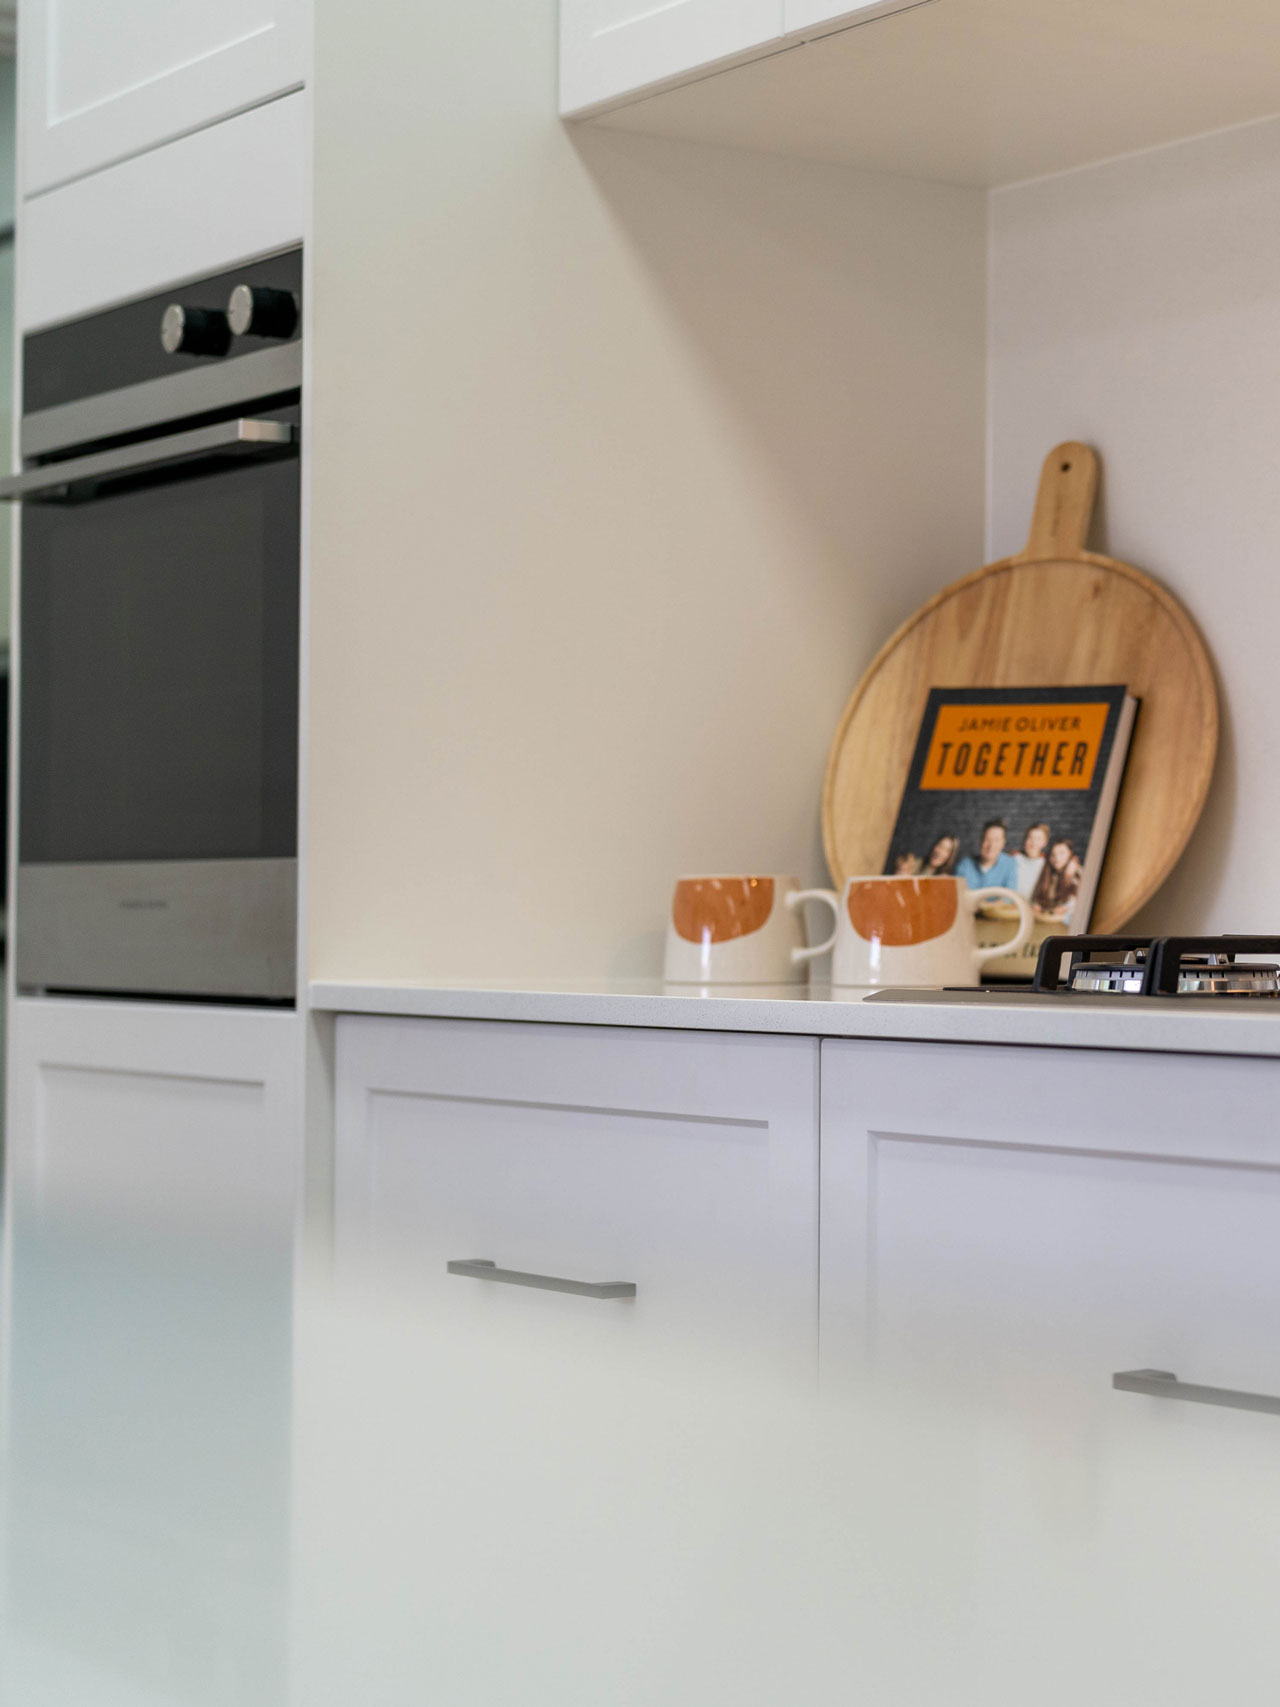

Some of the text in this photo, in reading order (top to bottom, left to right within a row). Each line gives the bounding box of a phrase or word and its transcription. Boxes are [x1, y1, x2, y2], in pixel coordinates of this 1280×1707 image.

[957, 716, 1081, 732] JAMIE OLIVER
[936, 741, 1088, 777] TOGETHER
